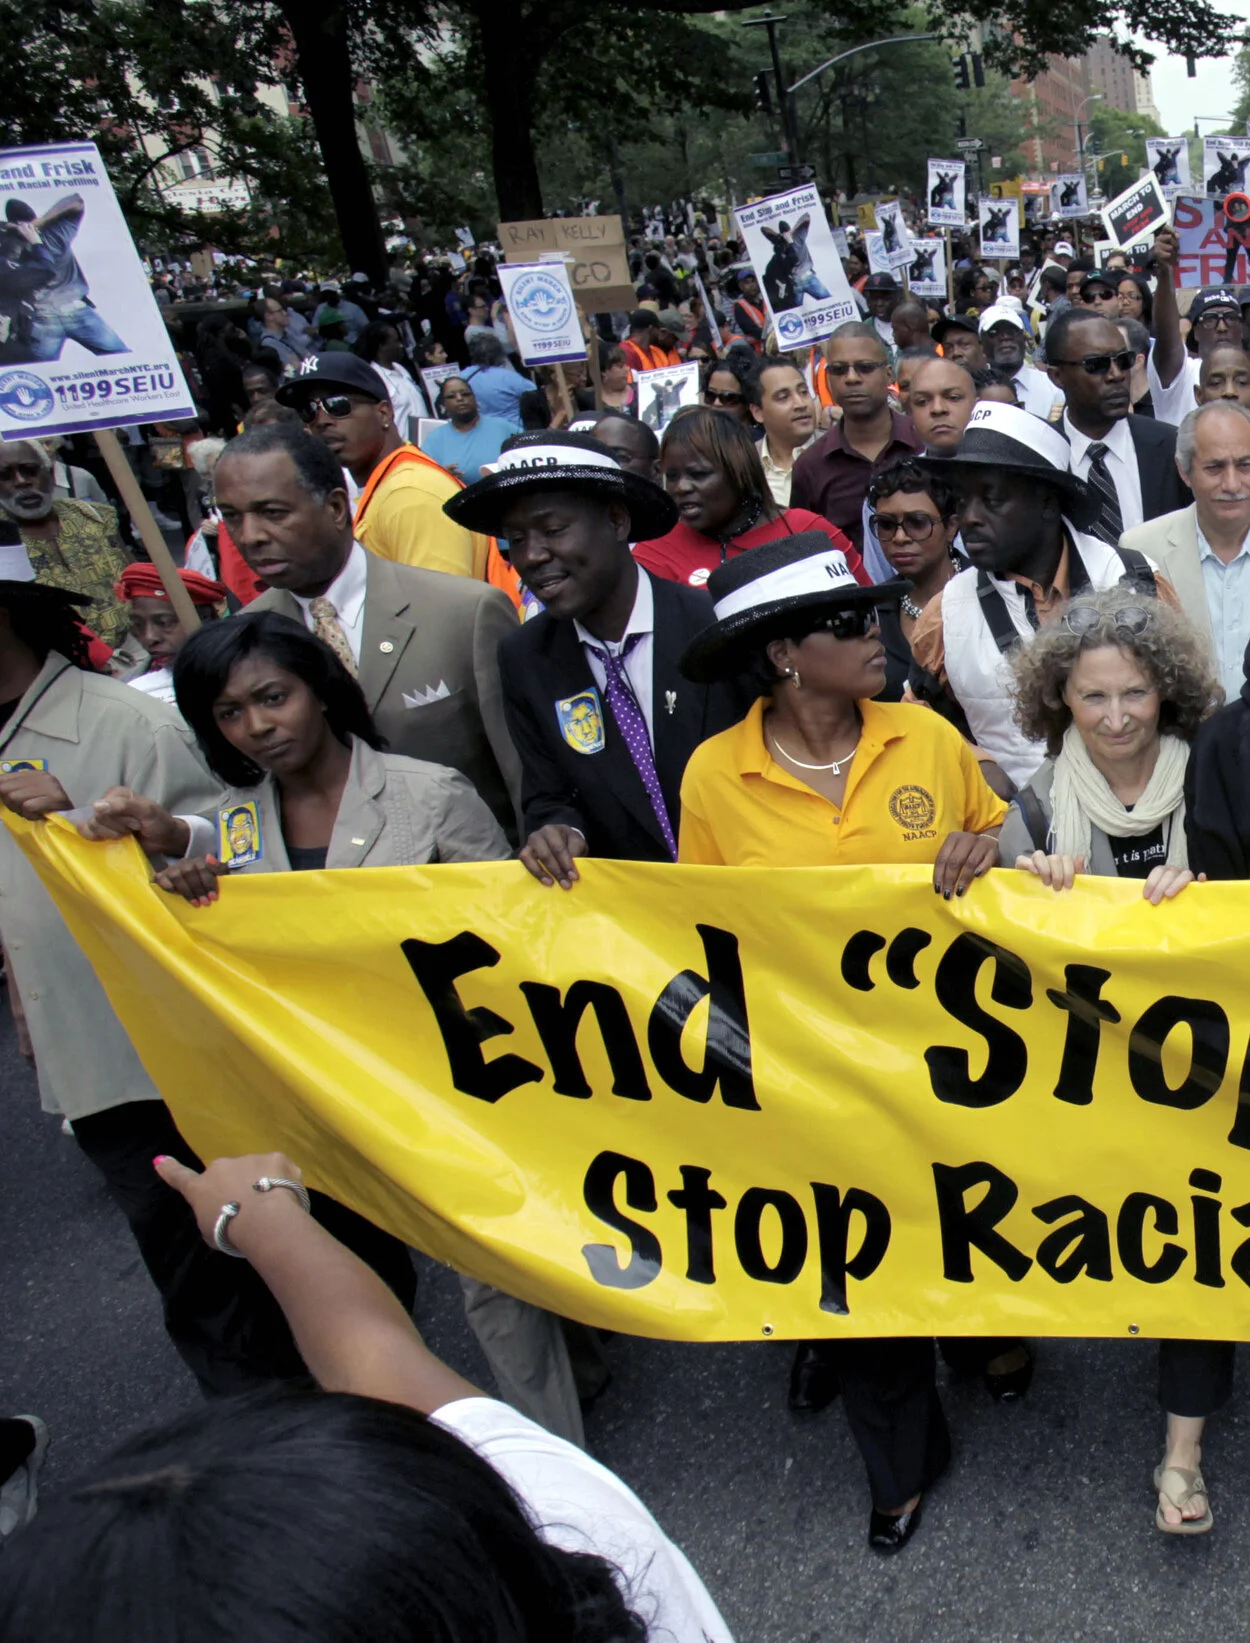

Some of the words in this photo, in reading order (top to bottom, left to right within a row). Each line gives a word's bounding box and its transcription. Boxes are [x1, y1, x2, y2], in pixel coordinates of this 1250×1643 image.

[1, 163, 35, 180] and
[41, 159, 96, 177] Frisk
[18, 179, 50, 190] Racial
[54, 176, 99, 189] Profiling
[740, 212, 755, 223] End
[792, 193, 815, 206] Frisk
[1110, 193, 1140, 220] MARCH
[1139, 184, 1152, 197] TO
[1126, 202, 1144, 220] END
[508, 226, 545, 245] RAY
[562, 224, 606, 241] KELLY
[1134, 245, 1147, 254] TO
[572, 261, 611, 285] GO
[299, 355, 319, 376] NY
[55, 372, 175, 403] 1199SEIU
[61, 401, 86, 412] United
[88, 397, 129, 409] Healthcare
[131, 393, 163, 404] Workers
[165, 390, 181, 400] East
[504, 456, 558, 470] AACP
[825, 562, 849, 579] NA
[902, 830, 937, 842] NAACP
[1131, 849, 1140, 861] is
[400, 924, 762, 1111] End
[581, 1150, 891, 1315] Stop
